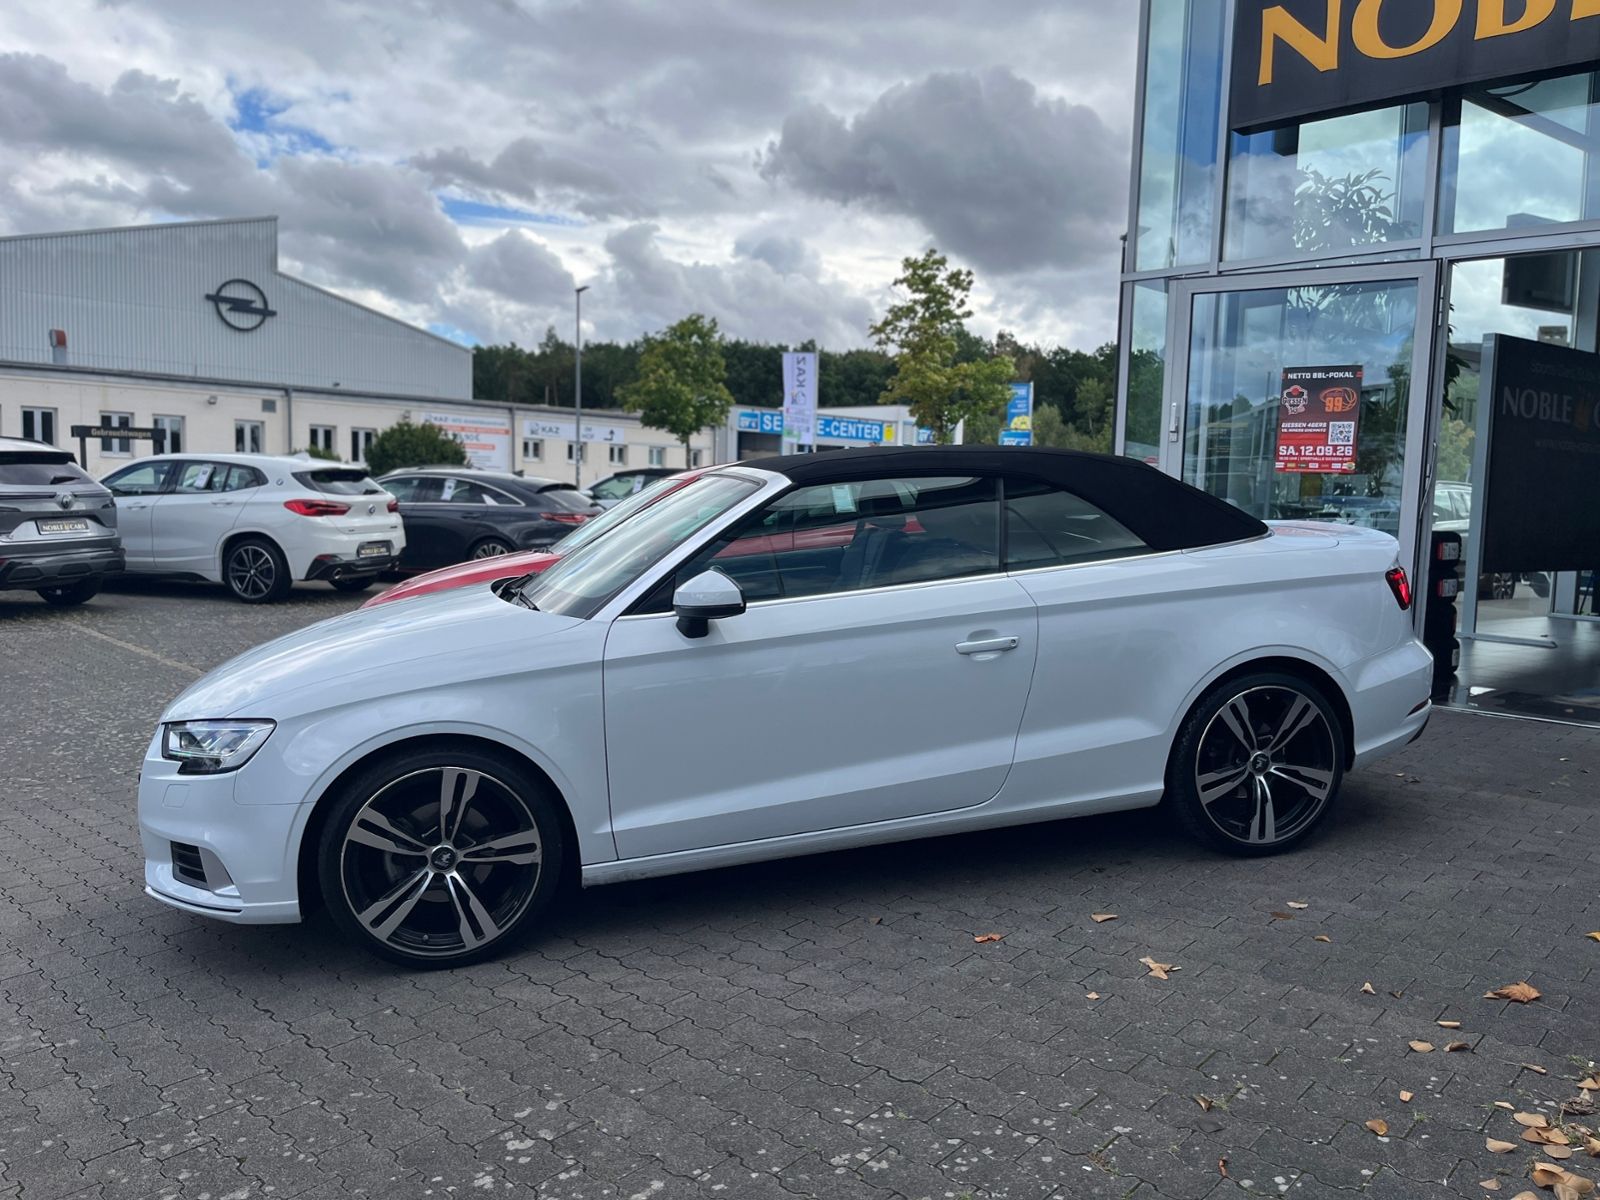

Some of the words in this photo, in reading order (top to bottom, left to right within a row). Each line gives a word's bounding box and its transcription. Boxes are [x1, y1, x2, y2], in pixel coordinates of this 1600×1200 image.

[1325, 397, 1343, 412] 99
[1502, 386, 1572, 423] NOBLE
[91, 428, 151, 438] Gebrauchtwagen
[541, 426, 560, 434] KAZ
[762, 414, 881, 439] SEE-CENTER
